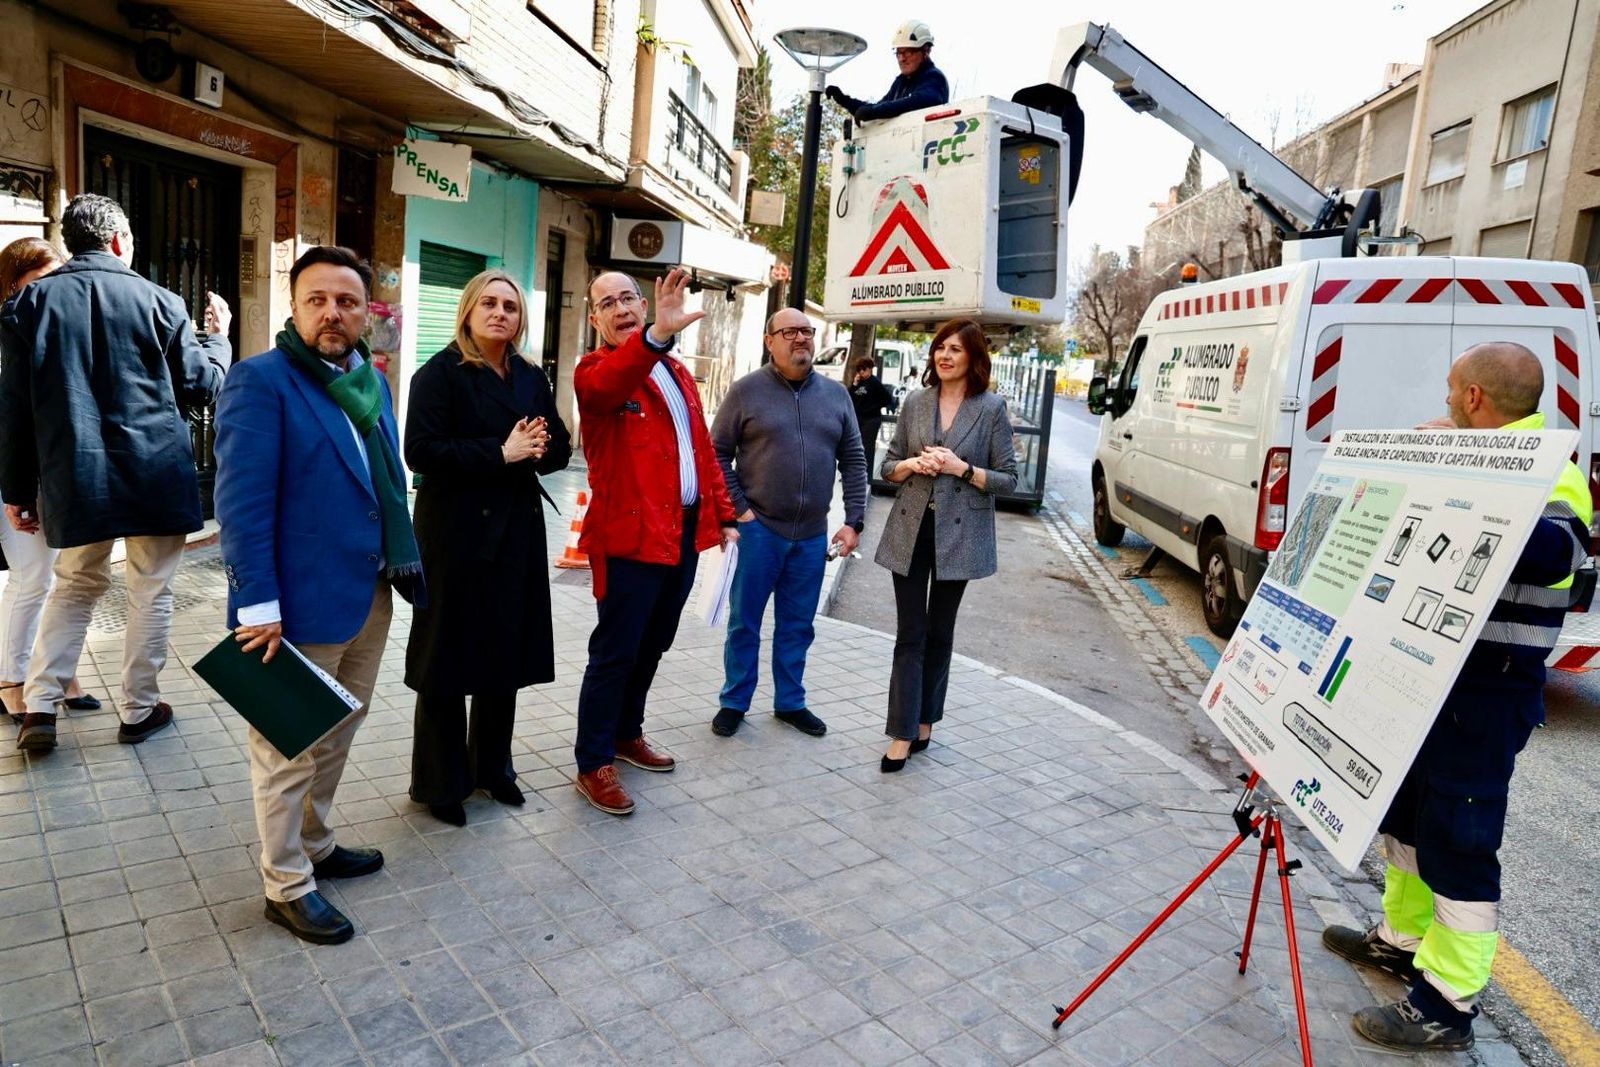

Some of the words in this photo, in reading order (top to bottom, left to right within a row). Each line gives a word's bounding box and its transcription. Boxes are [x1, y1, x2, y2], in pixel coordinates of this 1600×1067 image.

[210, 76, 218, 92] 6
[923, 135, 967, 169] FCC
[904, 281, 944, 297] PUBLICO
[1183, 343, 1235, 370] ALUMBRADO
[1184, 375, 1220, 402] PUBLICO
[1380, 433, 1391, 444] DE
[1389, 433, 1436, 446] LUMINARIAS
[1435, 434, 1455, 447] CON
[1455, 432, 1517, 450] TECNOLOGÍA
[1517, 436, 1542, 451] LED
[1334, 446, 1343, 456] EN
[1342, 447, 1360, 458] CALLE
[1359, 448, 1380, 459] ANCHA
[1379, 449, 1391, 460] DE
[1389, 450, 1438, 463] CAPUCHINOS
[1438, 452, 1446, 464] Y
[1445, 450, 1487, 468] CAPITÁN
[1485, 455, 1534, 472] MORENO
[1257, 730, 1275, 750] GRANADA
[1294, 713, 1309, 731] TOTAL
[1346, 758, 1369, 784] 59.604
[1366, 776, 1374, 788] €
[1290, 779, 1313, 807] FCC
[1312, 797, 1328, 817] UTE
[1324, 810, 1345, 835] 2024
